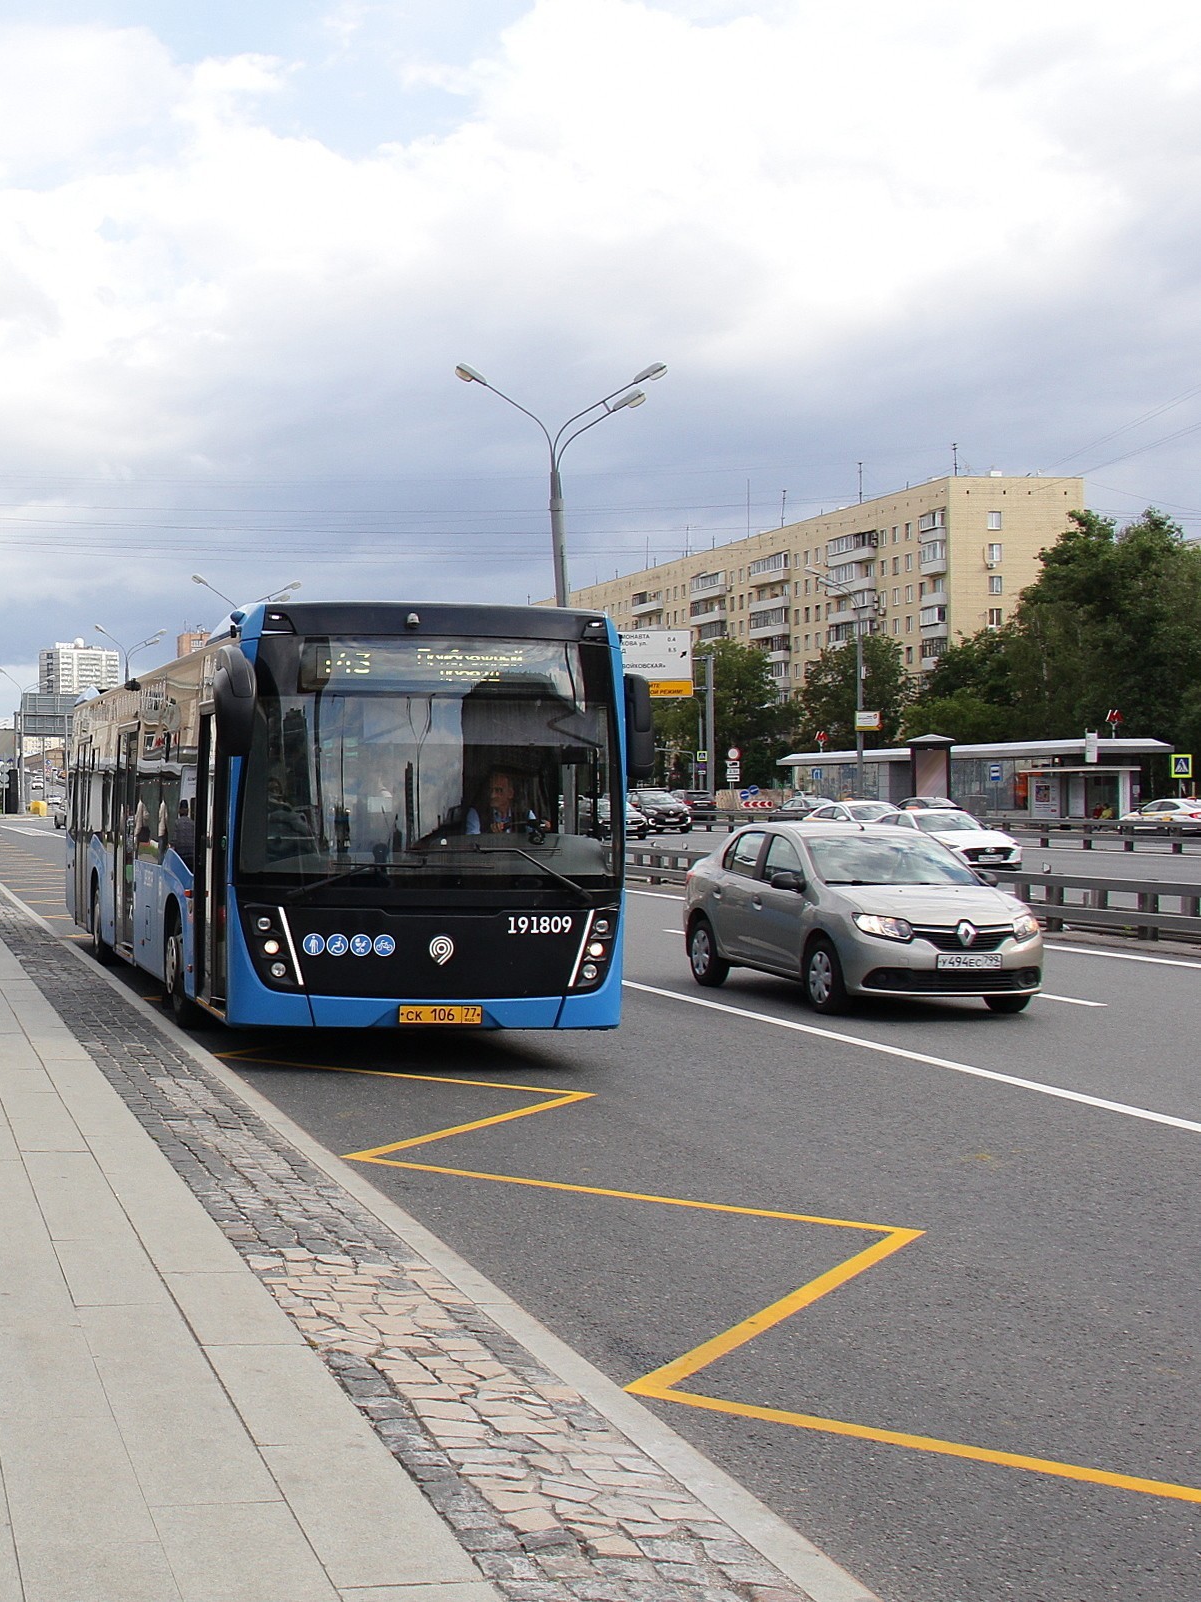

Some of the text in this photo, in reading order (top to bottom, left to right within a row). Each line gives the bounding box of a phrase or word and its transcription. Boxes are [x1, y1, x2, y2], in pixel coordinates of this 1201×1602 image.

[507, 915, 572, 934] 191809
[406, 1007, 477, 1021] СК 106 77
